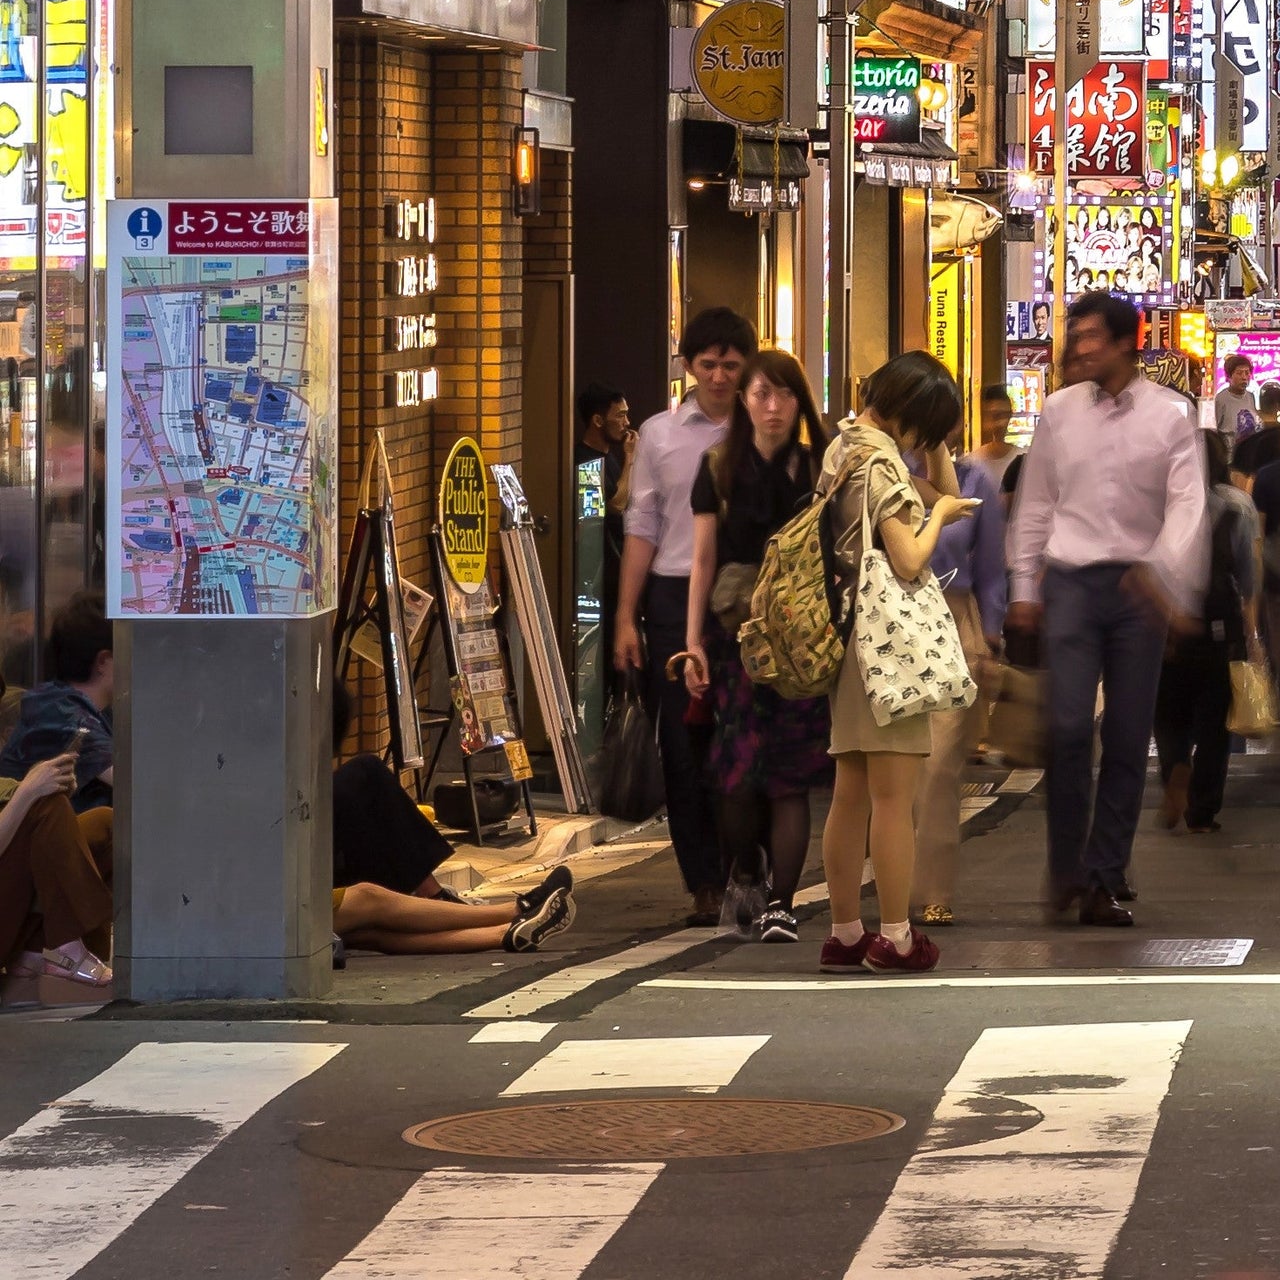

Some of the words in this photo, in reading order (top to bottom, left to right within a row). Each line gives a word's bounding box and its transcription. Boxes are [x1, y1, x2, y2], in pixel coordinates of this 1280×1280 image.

[141, 238, 149, 247] 3
[937, 289, 947, 322] Tuna
[455, 456, 476, 477] THE
[446, 478, 484, 515] Public
[447, 518, 484, 552] Stand
